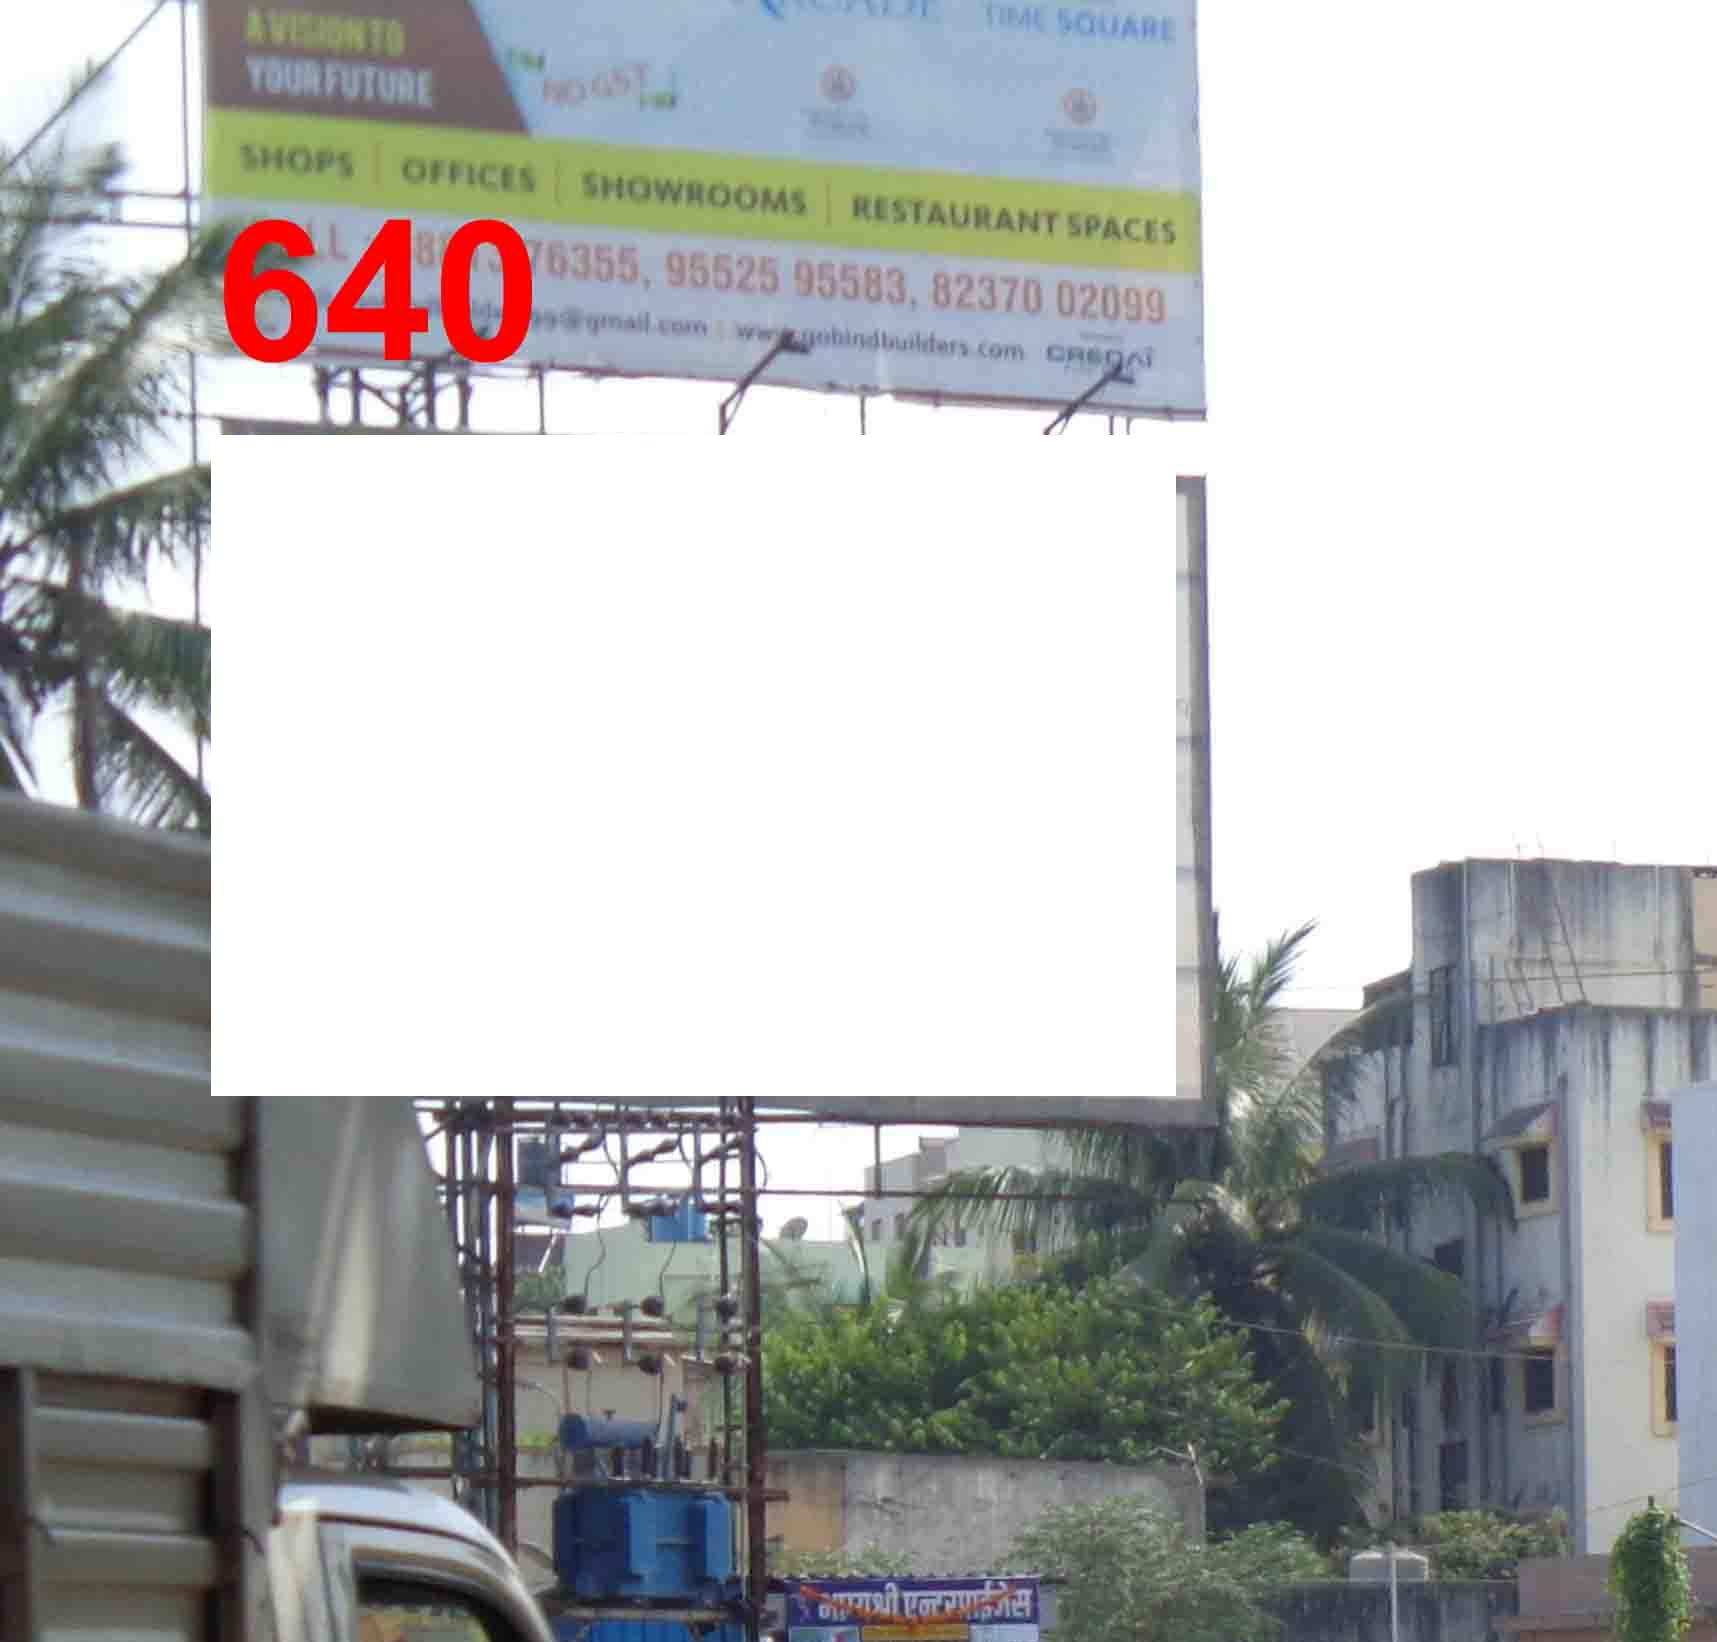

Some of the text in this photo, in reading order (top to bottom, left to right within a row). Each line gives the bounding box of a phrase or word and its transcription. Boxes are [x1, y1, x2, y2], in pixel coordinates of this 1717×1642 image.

[247, 10, 264, 43] A
[265, 12, 363, 52] VISION
[984, 7, 1176, 42] TIME SQUARE
[247, 55, 433, 107] YOUR FUTURE
[240, 143, 354, 178] SHOPS
[401, 157, 536, 193] OFFICES
[580, 171, 807, 216] SHOWROOMS
[852, 193, 1177, 246] RESTAURANT SPACES
[666, 250, 783, 295] 95525
[793, 257, 918, 311] 95583,
[932, 270, 1042, 319] 82370
[1056, 279, 1169, 325] 02099
